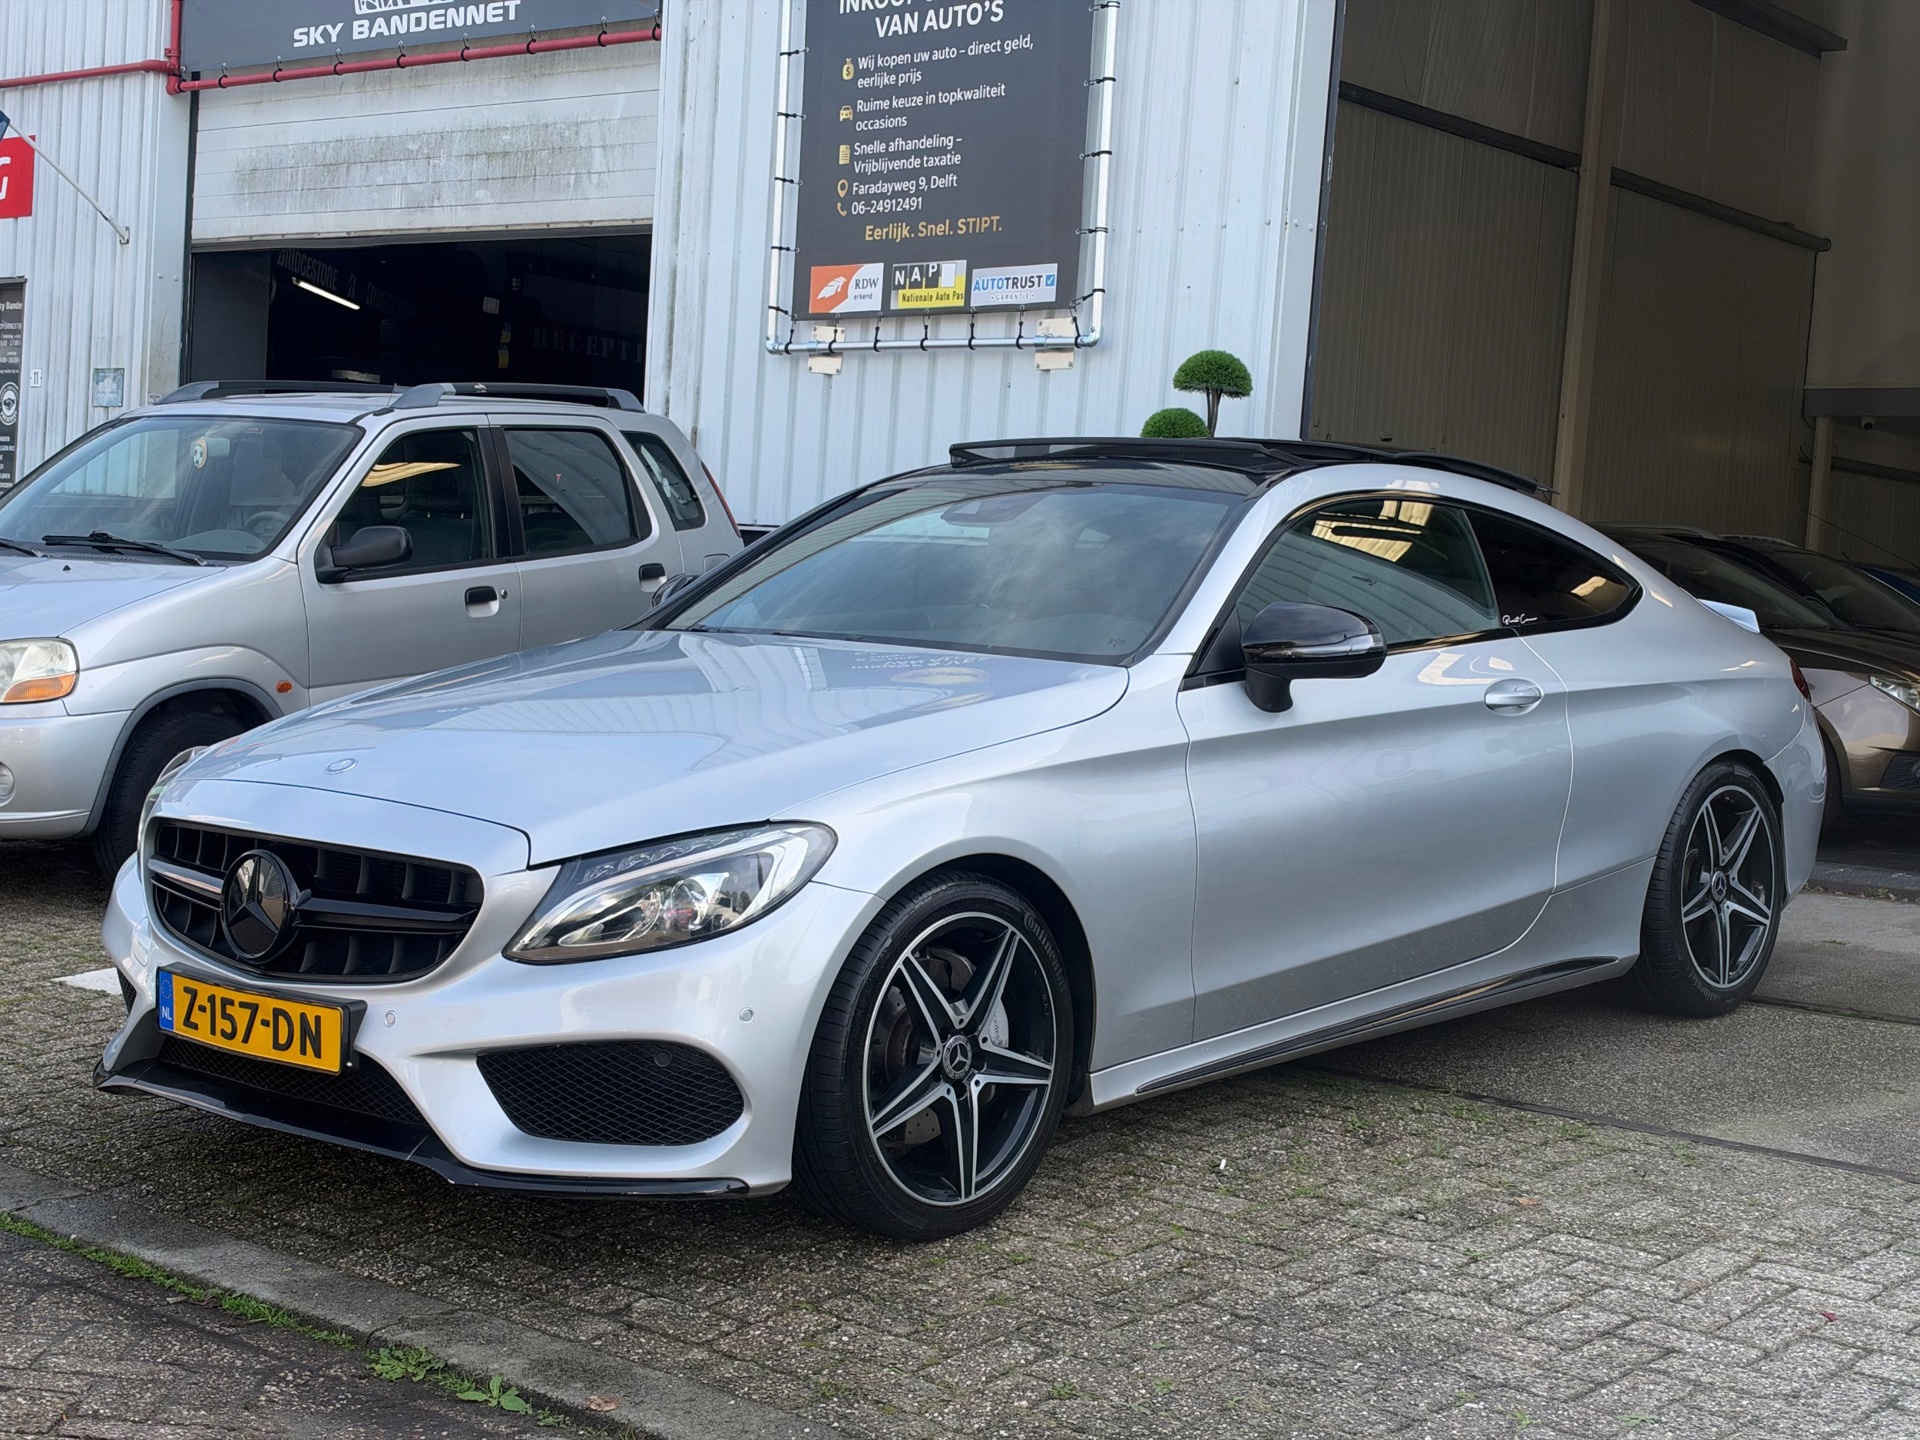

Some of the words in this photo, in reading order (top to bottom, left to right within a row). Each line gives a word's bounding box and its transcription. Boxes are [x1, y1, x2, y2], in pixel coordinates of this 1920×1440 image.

[293, 22, 344, 48] SKY
[352, 0, 521, 40] BANDENNET
[875, 11, 919, 38] VAN
[922, 0, 1004, 32] AUTO’S
[858, 55, 875, 71] Wij
[877, 52, 911, 69] kopen
[913, 50, 930, 63] uw
[932, 47, 957, 61] auto
[968, 40, 1001, 56] direct
[1004, 34, 1034, 54] geld,
[857, 71, 896, 89] eerlijke
[898, 68, 922, 86] prijs
[856, 97, 890, 113] Ruime
[892, 95, 923, 109] keuze
[925, 92, 936, 105] in
[938, 83, 1006, 105] topkwaliteit
[855, 115, 908, 131] occasions
[853, 140, 887, 156] Snelle
[888, 134, 954, 153] afhandeling
[854, 155, 921, 175] Vrijblijvende
[923, 151, 962, 168] taxatie
[852, 179, 916, 196] Faradayweg
[918, 176, 928, 192] 9,
[930, 173, 958, 189] Delft
[851, 196, 923, 215] 06-24912491
[865, 222, 915, 243] Eerlijk.
[917, 219, 953, 238] Snel.
[957, 215, 1003, 235] STIPT.
[854, 278, 879, 290] RDW
[973, 274, 1043, 292] AUTOTRUST
[853, 292, 873, 301] erkend
[902, 291, 933, 303] Nationale
[935, 291, 951, 302] Auto
[995, 293, 1030, 301] GARANTIE
[1024, 909, 1067, 992] Continental
[161, 1005, 173, 1021] NL
[182, 986, 322, 1059] Z-157-DN
